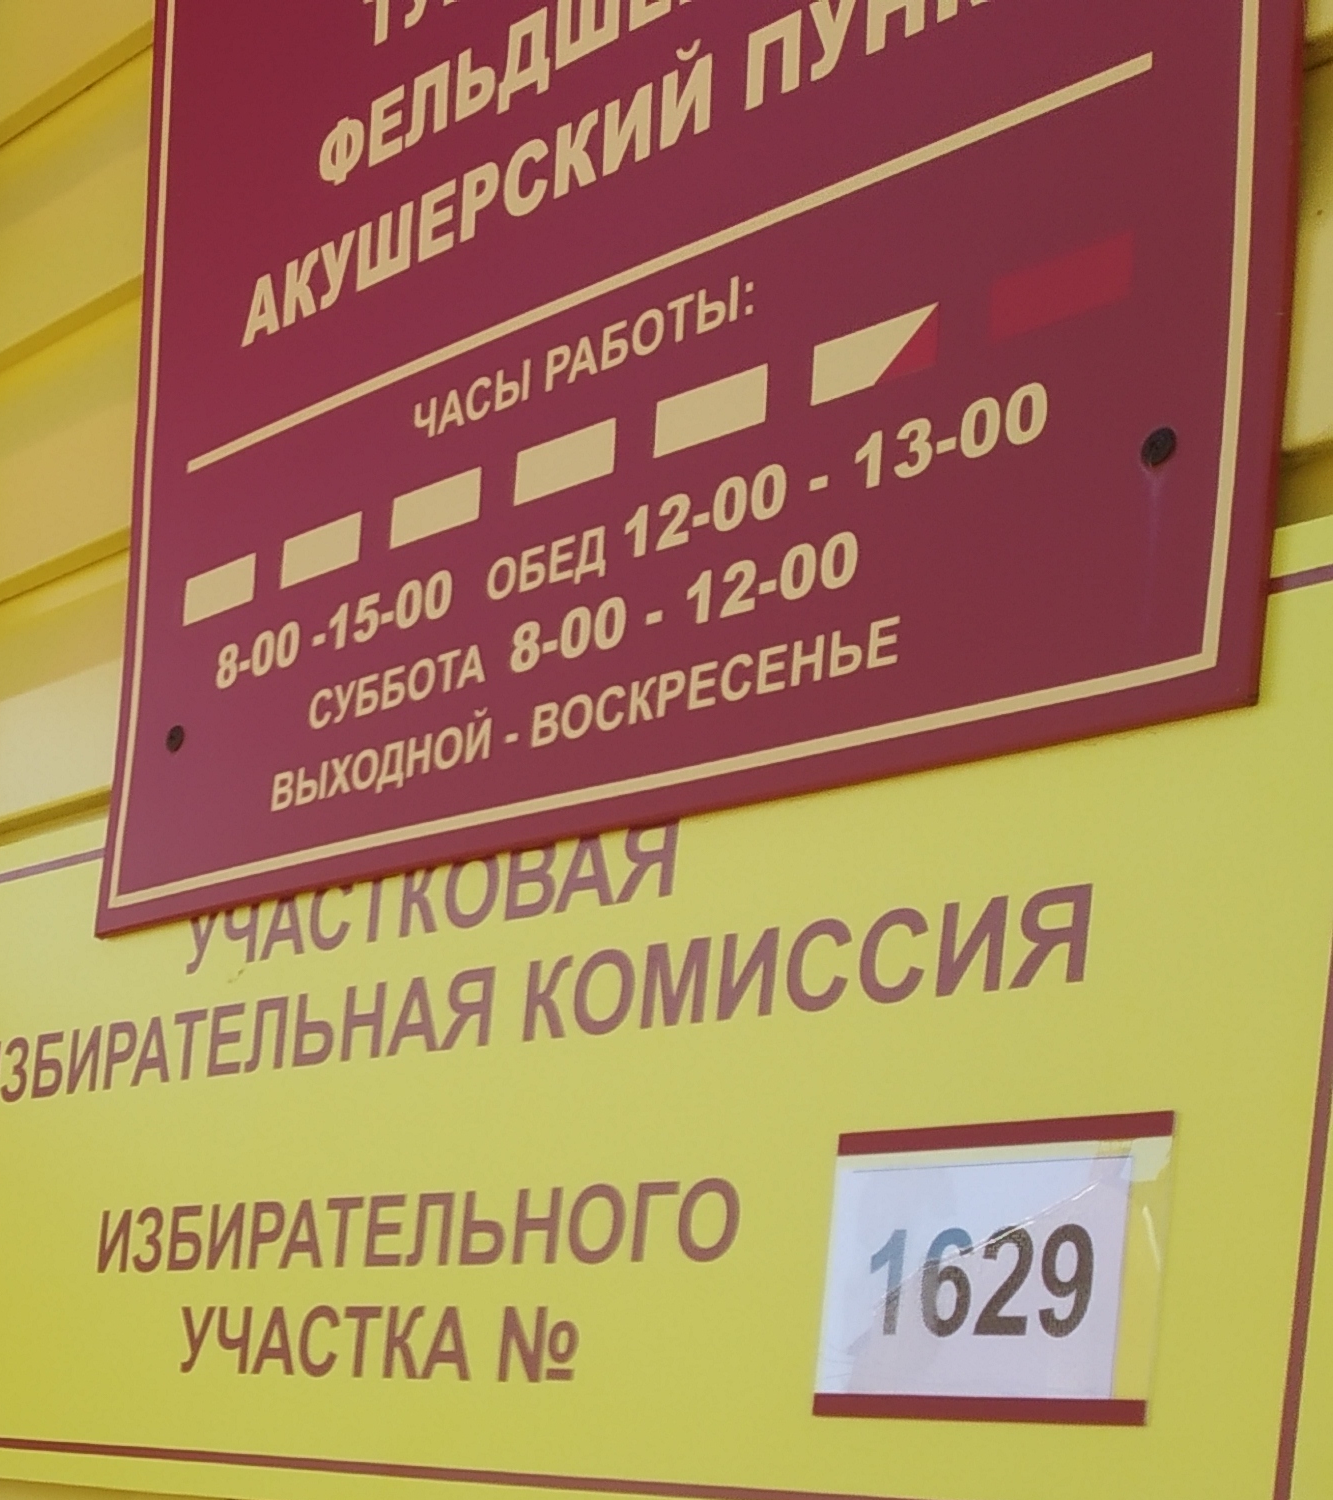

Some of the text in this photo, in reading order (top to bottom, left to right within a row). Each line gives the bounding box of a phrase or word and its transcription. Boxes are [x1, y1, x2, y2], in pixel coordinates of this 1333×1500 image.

[241, 38, 713, 347] АКУШЕРСКИЙ
[414, 275, 756, 440] ЧАСЫ РАБОТЫ:
[216, 621, 300, 690] 8-00
[487, 525, 606, 601] ОБЕД
[624, 464, 787, 557] 12-00
[855, 382, 1048, 489] 13-00
[309, 645, 486, 730] СУББОТА
[510, 597, 626, 673] 8-00
[686, 531, 859, 624] 12-00
[271, 707, 493, 812] ВЫХОДНОЙ
[531, 616, 900, 748] ВОСКРЕСЕНЬЕ
[185, 818, 681, 975] УЧАСТКОВАЯ
[522, 883, 1096, 1044] КОМИССИЯ
[96, 1177, 738, 1275] ИЗБИРАТЕЛЬНОГО
[870, 1223, 1094, 1338] 1629
[178, 1304, 579, 1384] УЧАСТКА №
